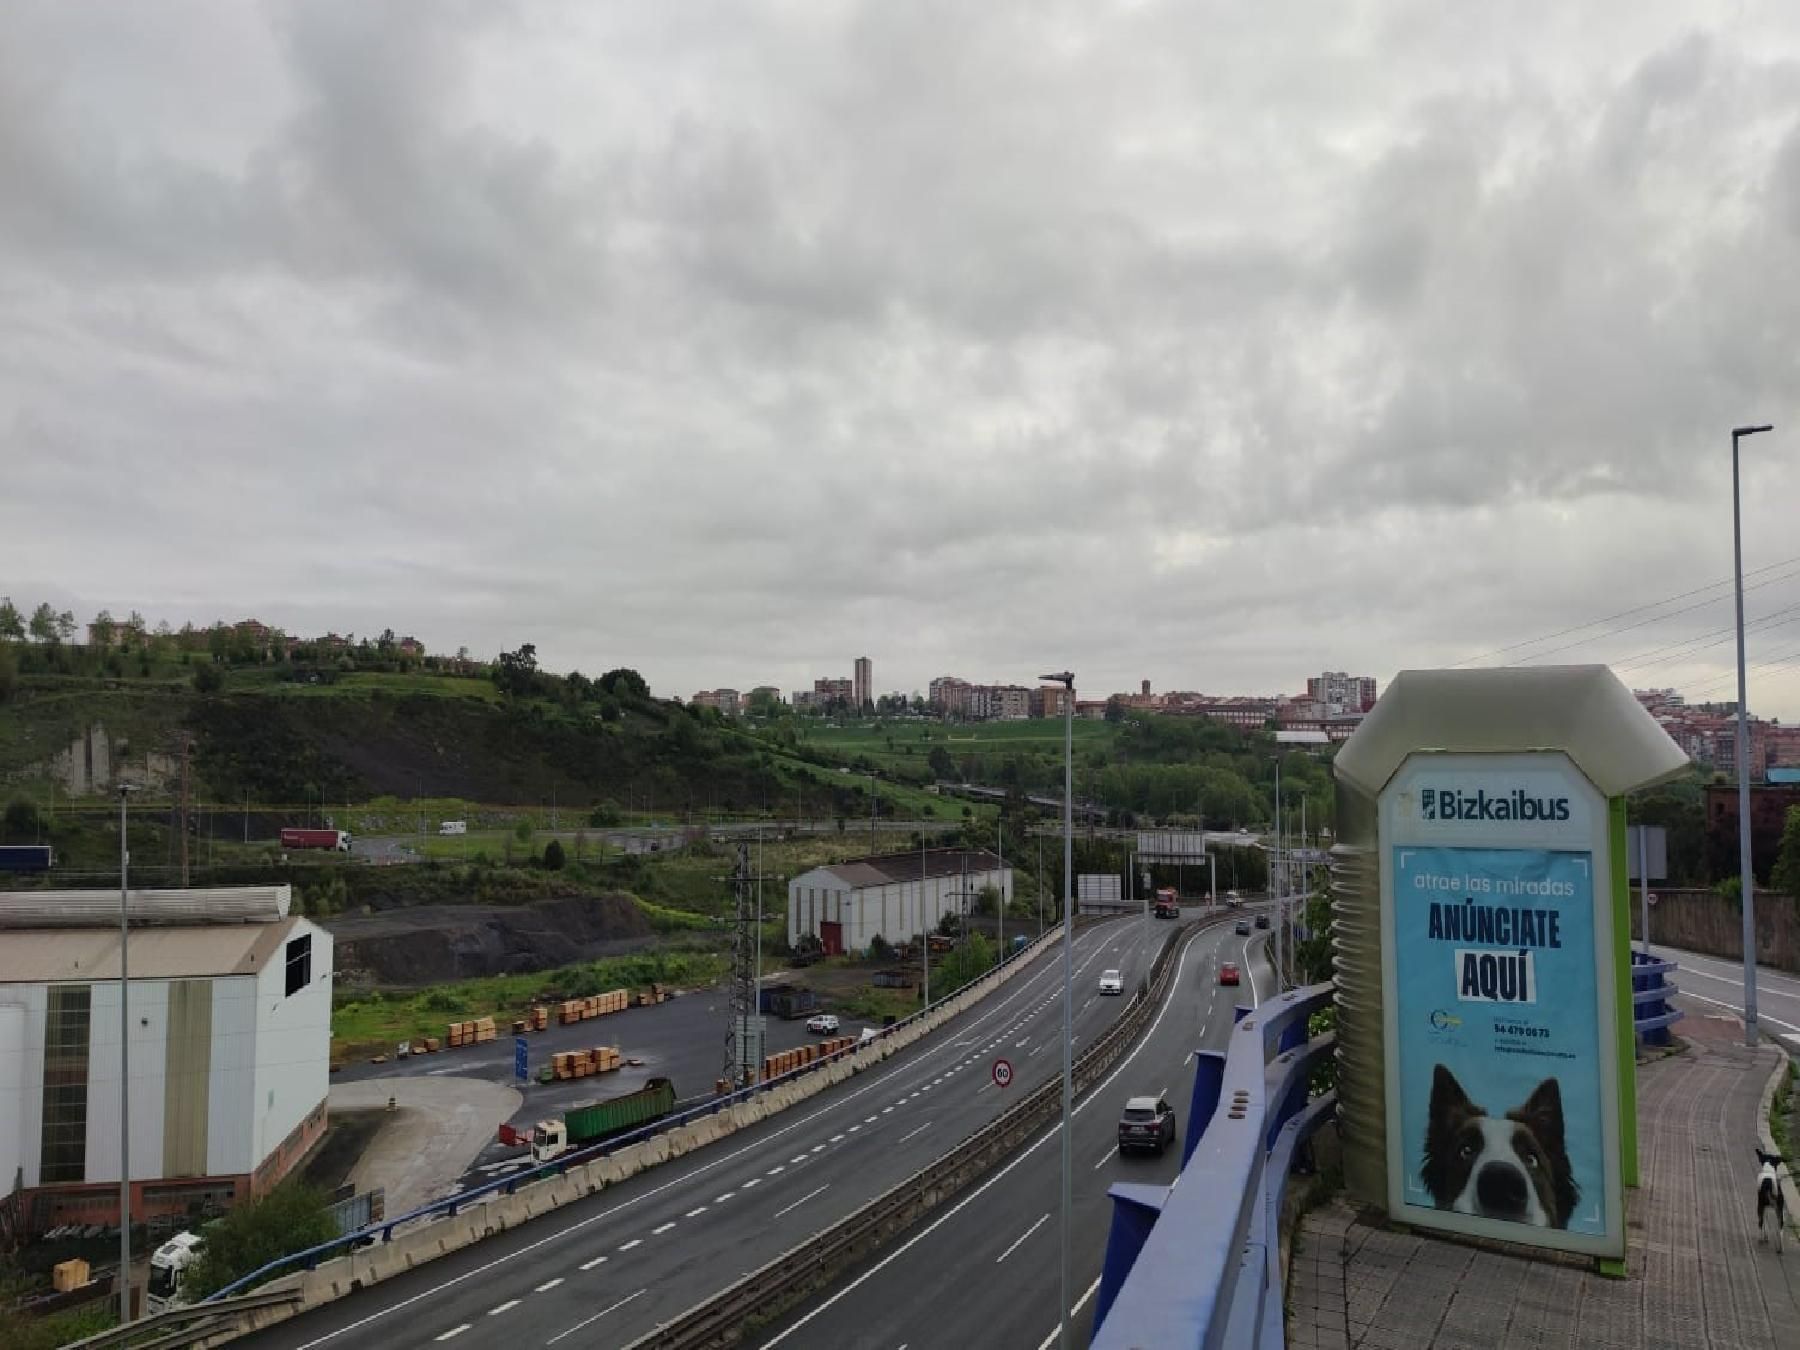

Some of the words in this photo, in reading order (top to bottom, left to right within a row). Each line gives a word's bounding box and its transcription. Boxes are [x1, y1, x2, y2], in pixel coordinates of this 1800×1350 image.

[1440, 790, 1569, 820] Bizkaibus
[1415, 873, 1459, 890] atrae
[1465, 874, 1490, 892] las
[1496, 877, 1574, 895] miradas
[1429, 898, 1561, 948] ANÚNCIATE
[1463, 949, 1527, 1001] AQUÍ
[997, 1068, 1008, 1077] 60
